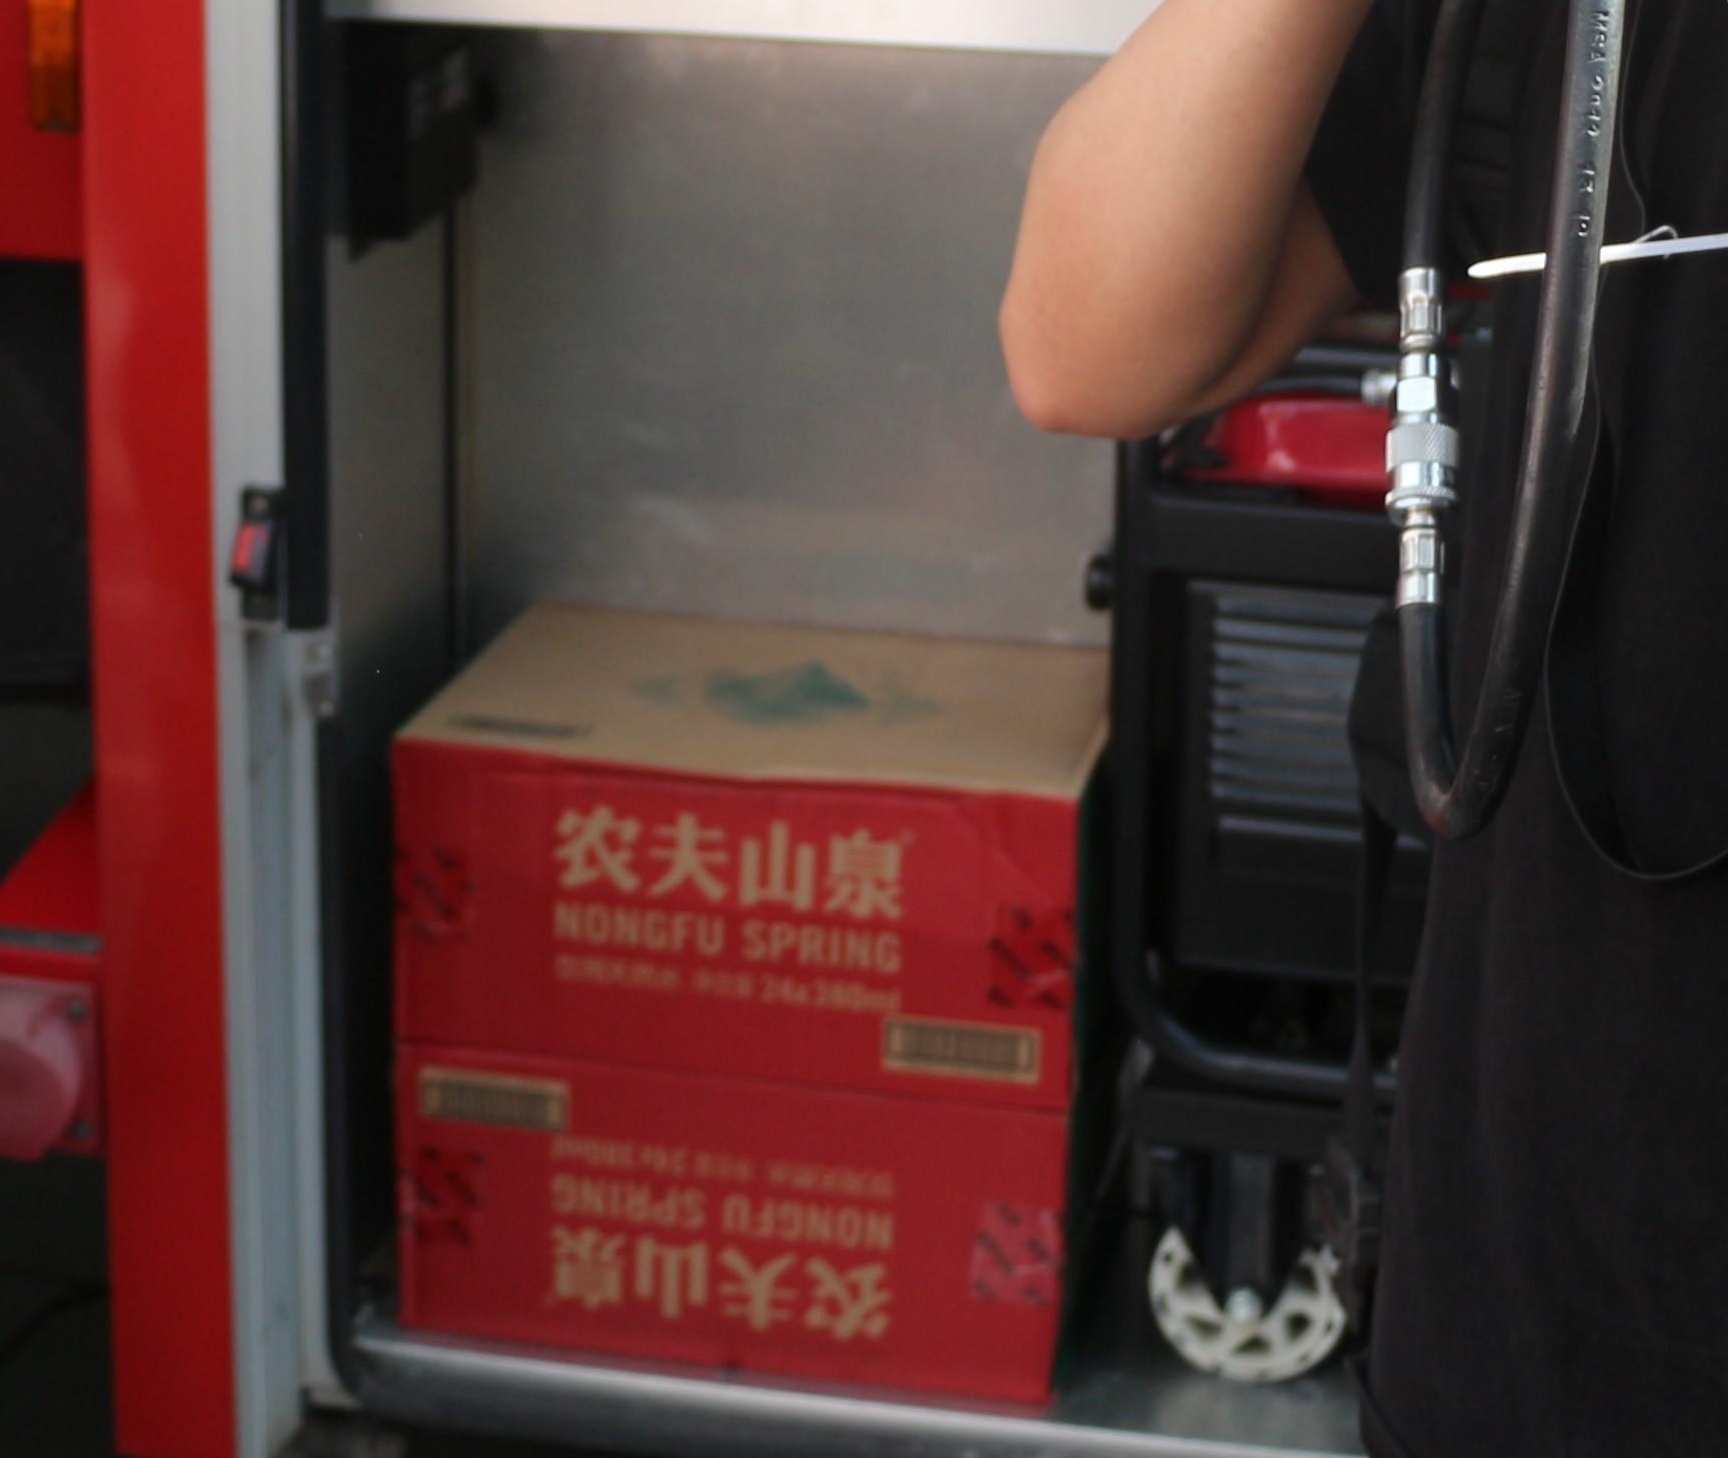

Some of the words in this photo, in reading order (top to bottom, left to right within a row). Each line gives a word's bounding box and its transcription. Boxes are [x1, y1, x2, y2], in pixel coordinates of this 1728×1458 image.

[554, 804, 904, 920] 农夫山泉
[553, 899, 727, 958] NONGFU
[740, 917, 902, 974] SPRING
[550, 1172, 708, 1231] SPRING
[721, 1192, 894, 1251] NONGFU
[551, 1226, 892, 1340] 农夫山泉
